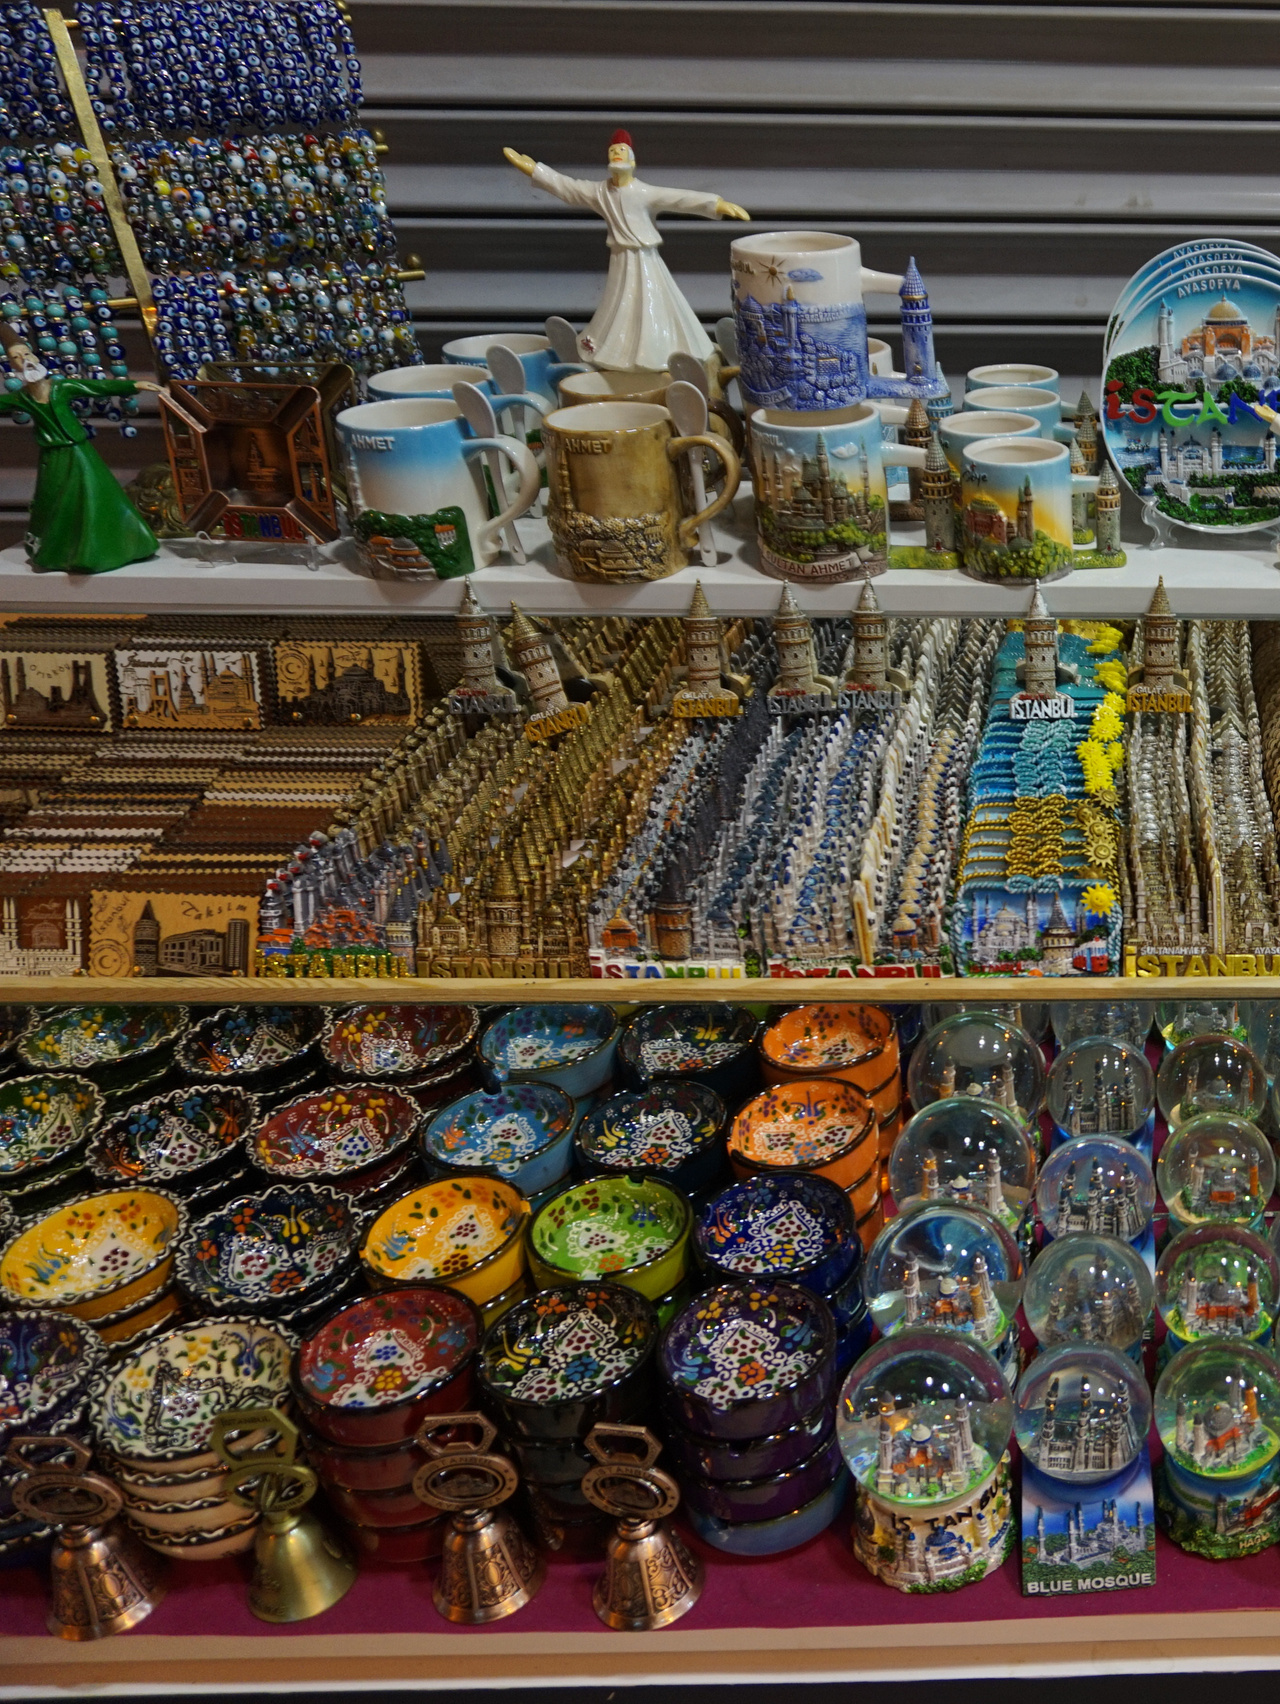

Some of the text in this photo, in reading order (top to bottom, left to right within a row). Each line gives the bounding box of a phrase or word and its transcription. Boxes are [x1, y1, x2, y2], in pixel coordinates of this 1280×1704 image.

[1177, 278, 1241, 299] AYASOFYA
[351, 435, 396, 452] AHMET
[565, 437, 612, 454] AHMET
[811, 558, 853, 576] AHMET
[1028, 1572, 1152, 1594] BLUE MOSQUE
